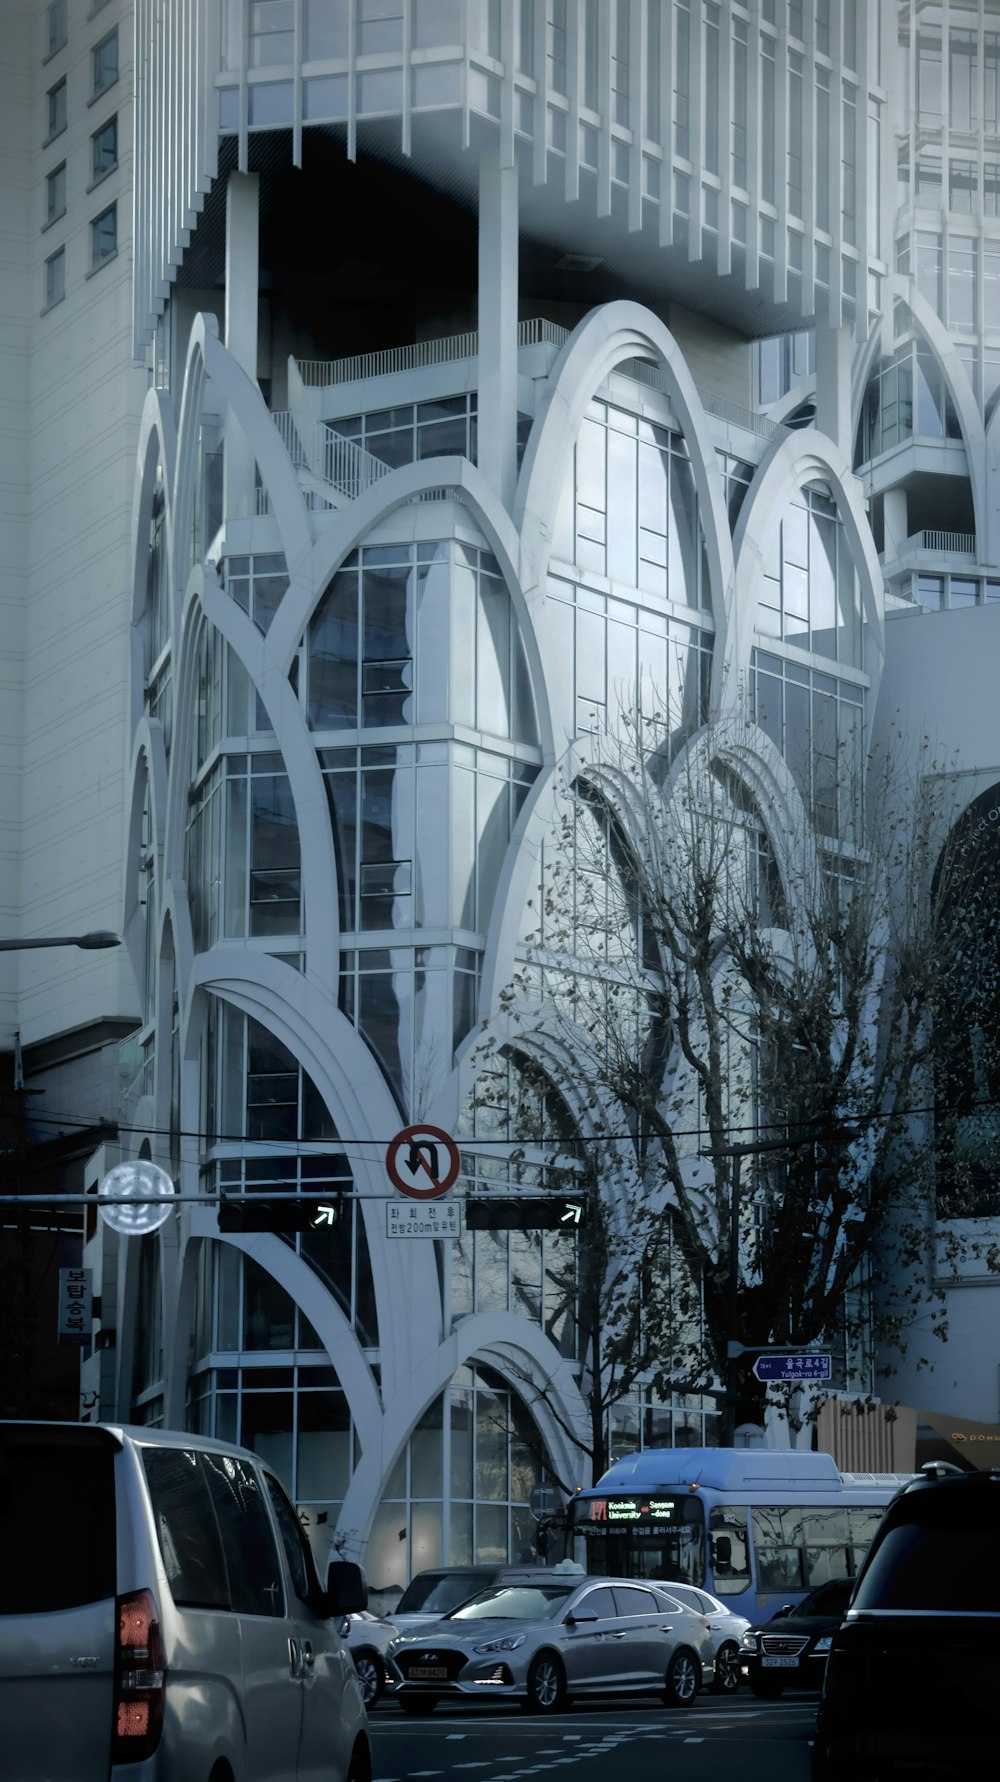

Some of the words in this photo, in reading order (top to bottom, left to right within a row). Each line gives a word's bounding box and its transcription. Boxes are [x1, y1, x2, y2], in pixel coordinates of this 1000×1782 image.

[65, 1270, 87, 1331] 보탑승복
[786, 1358, 828, 1370] 율곡로4길
[781, 1370, 812, 1379] Yulgok-ro
[813, 1369, 828, 1378] 4-gil
[608, 1502, 636, 1510] Kookmin
[649, 1501, 674, 1509] Sangam
[608, 1511, 641, 1519] University
